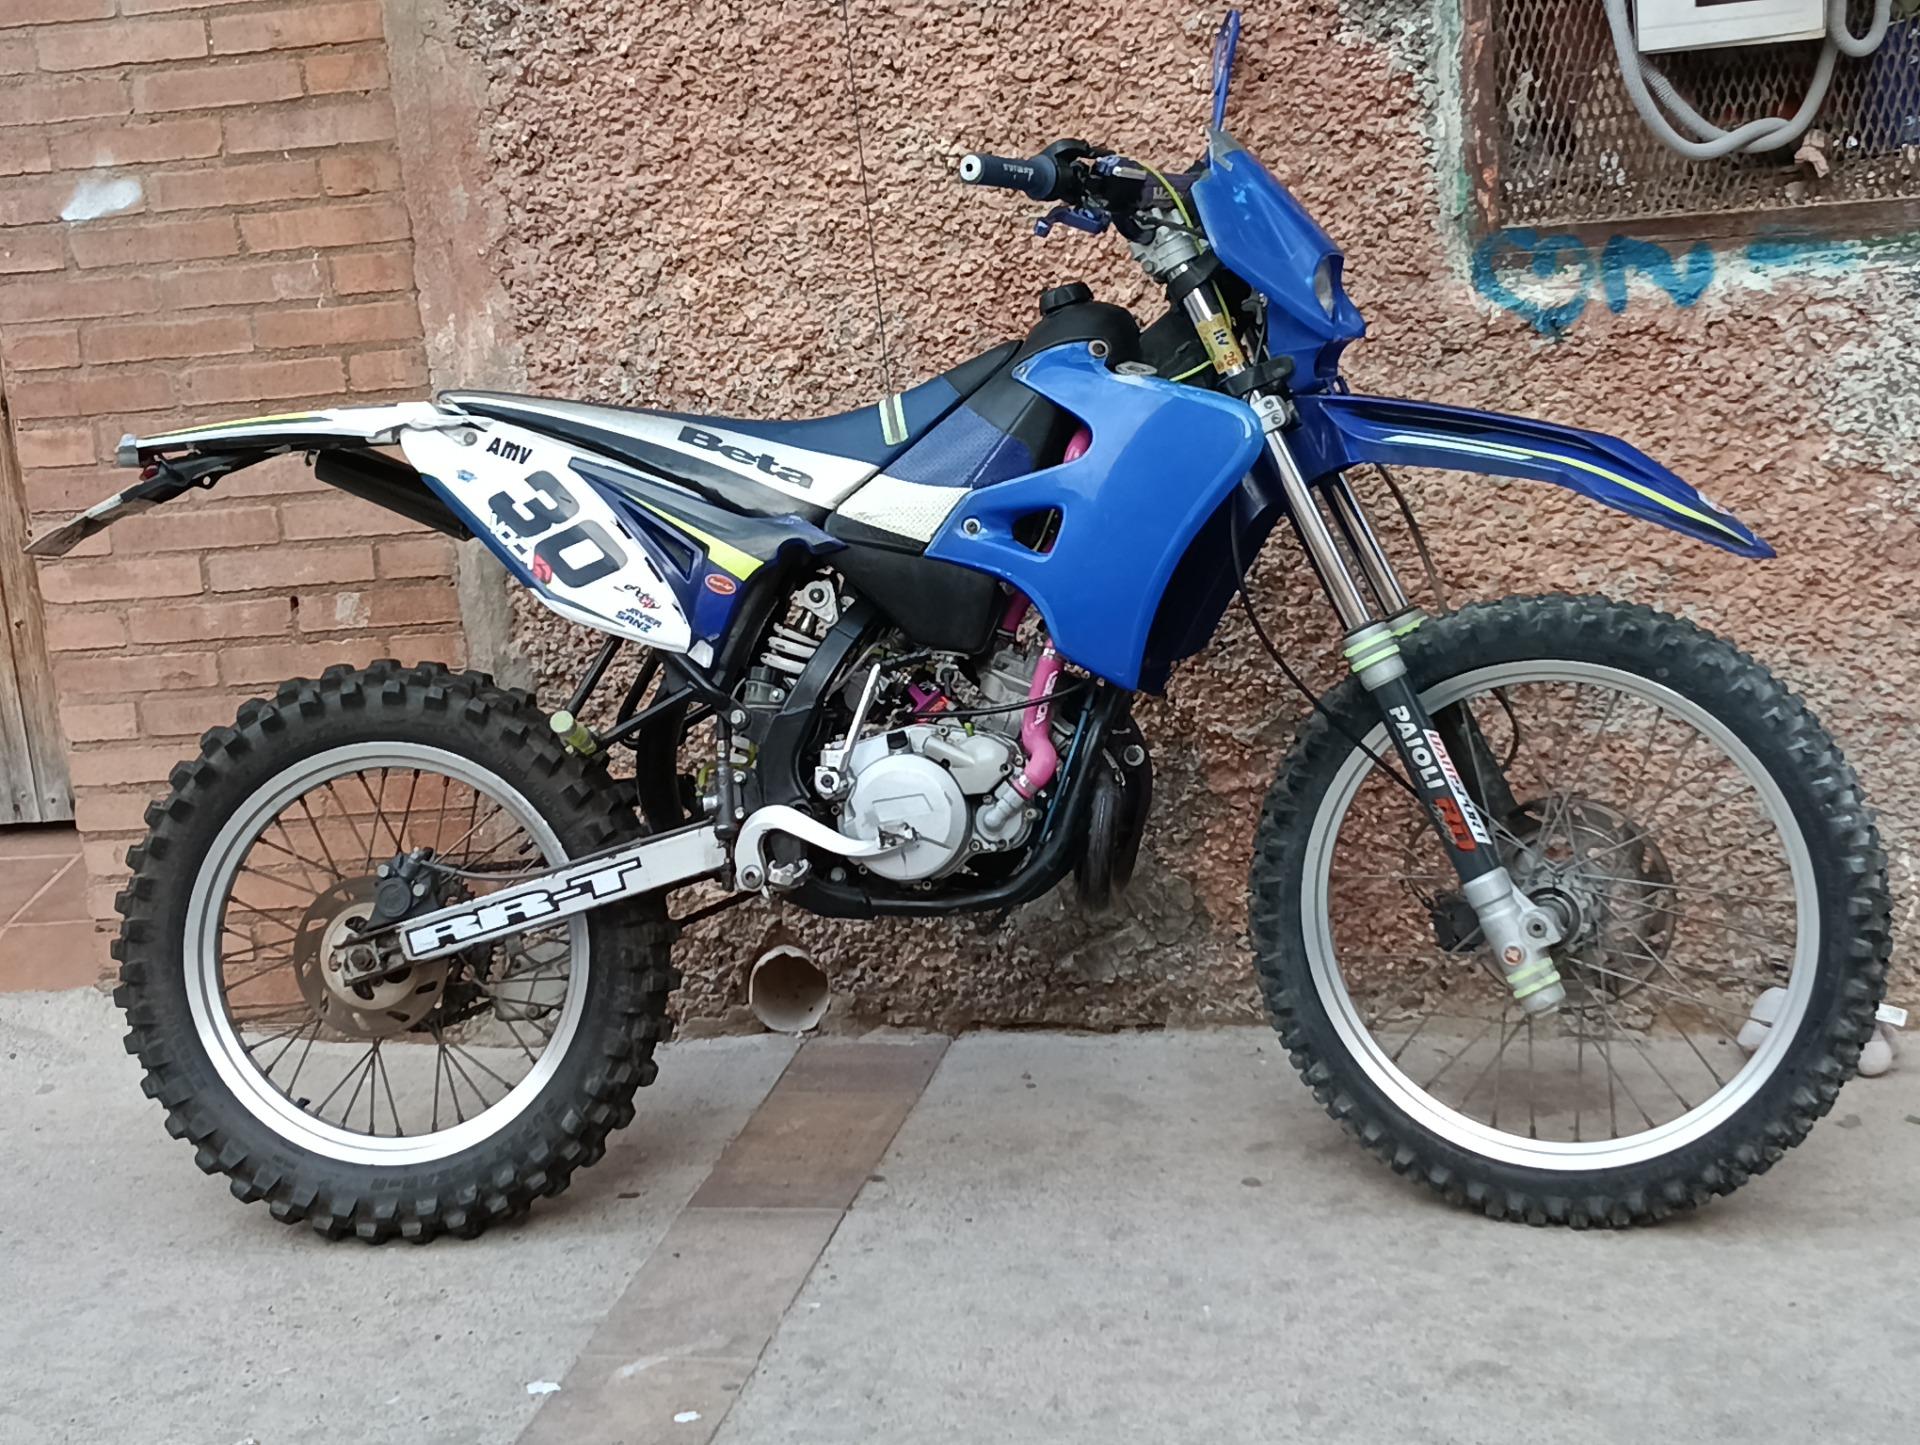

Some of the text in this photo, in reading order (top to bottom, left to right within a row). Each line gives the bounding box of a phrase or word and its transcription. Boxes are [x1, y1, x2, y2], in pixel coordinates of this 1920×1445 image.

[678, 425, 814, 489] Beta
[488, 470, 629, 588] 30
[615, 610, 652, 633] SANZ
[1389, 705, 1445, 789] PAIOLI
[406, 857, 642, 957] RR-T
